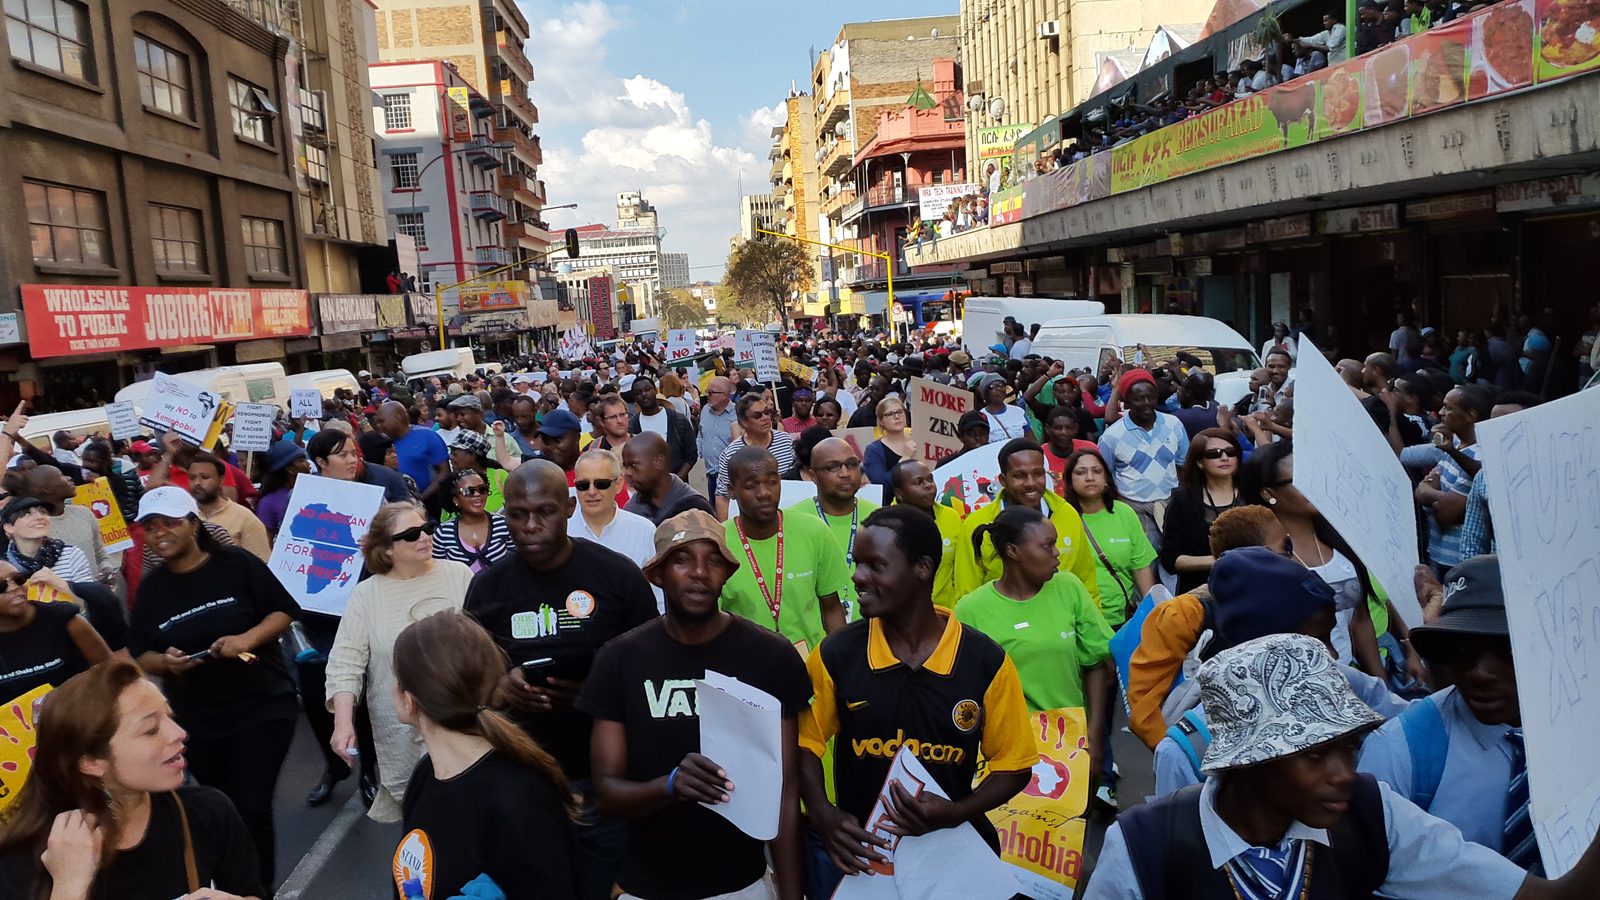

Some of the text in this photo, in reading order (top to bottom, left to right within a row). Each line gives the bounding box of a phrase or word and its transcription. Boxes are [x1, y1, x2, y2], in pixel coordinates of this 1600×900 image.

[43, 289, 130, 312] WHOLESALE
[600, 281, 611, 336] JOHANNESBURG
[54, 313, 128, 337] TO PUBLIC
[144, 294, 211, 341] JOBURG
[672, 348, 689, 358] NO
[164, 402, 197, 420] say NO to
[920, 386, 966, 413] MORE
[154, 411, 197, 434] Xenophobia
[299, 507, 367, 527] NO AFRICAN
[315, 528, 339, 540] IS A
[284, 543, 355, 565] FOREIGNER
[279, 560, 350, 583] IN AFRICA
[514, 613, 535, 622] one
[514, 627, 536, 637] can
[3, 671, 15, 679] and
[15, 668, 34, 676] Shake
[644, 679, 701, 718] VA
[852, 728, 965, 763] vodacom
[402, 848, 422, 872] STAND
